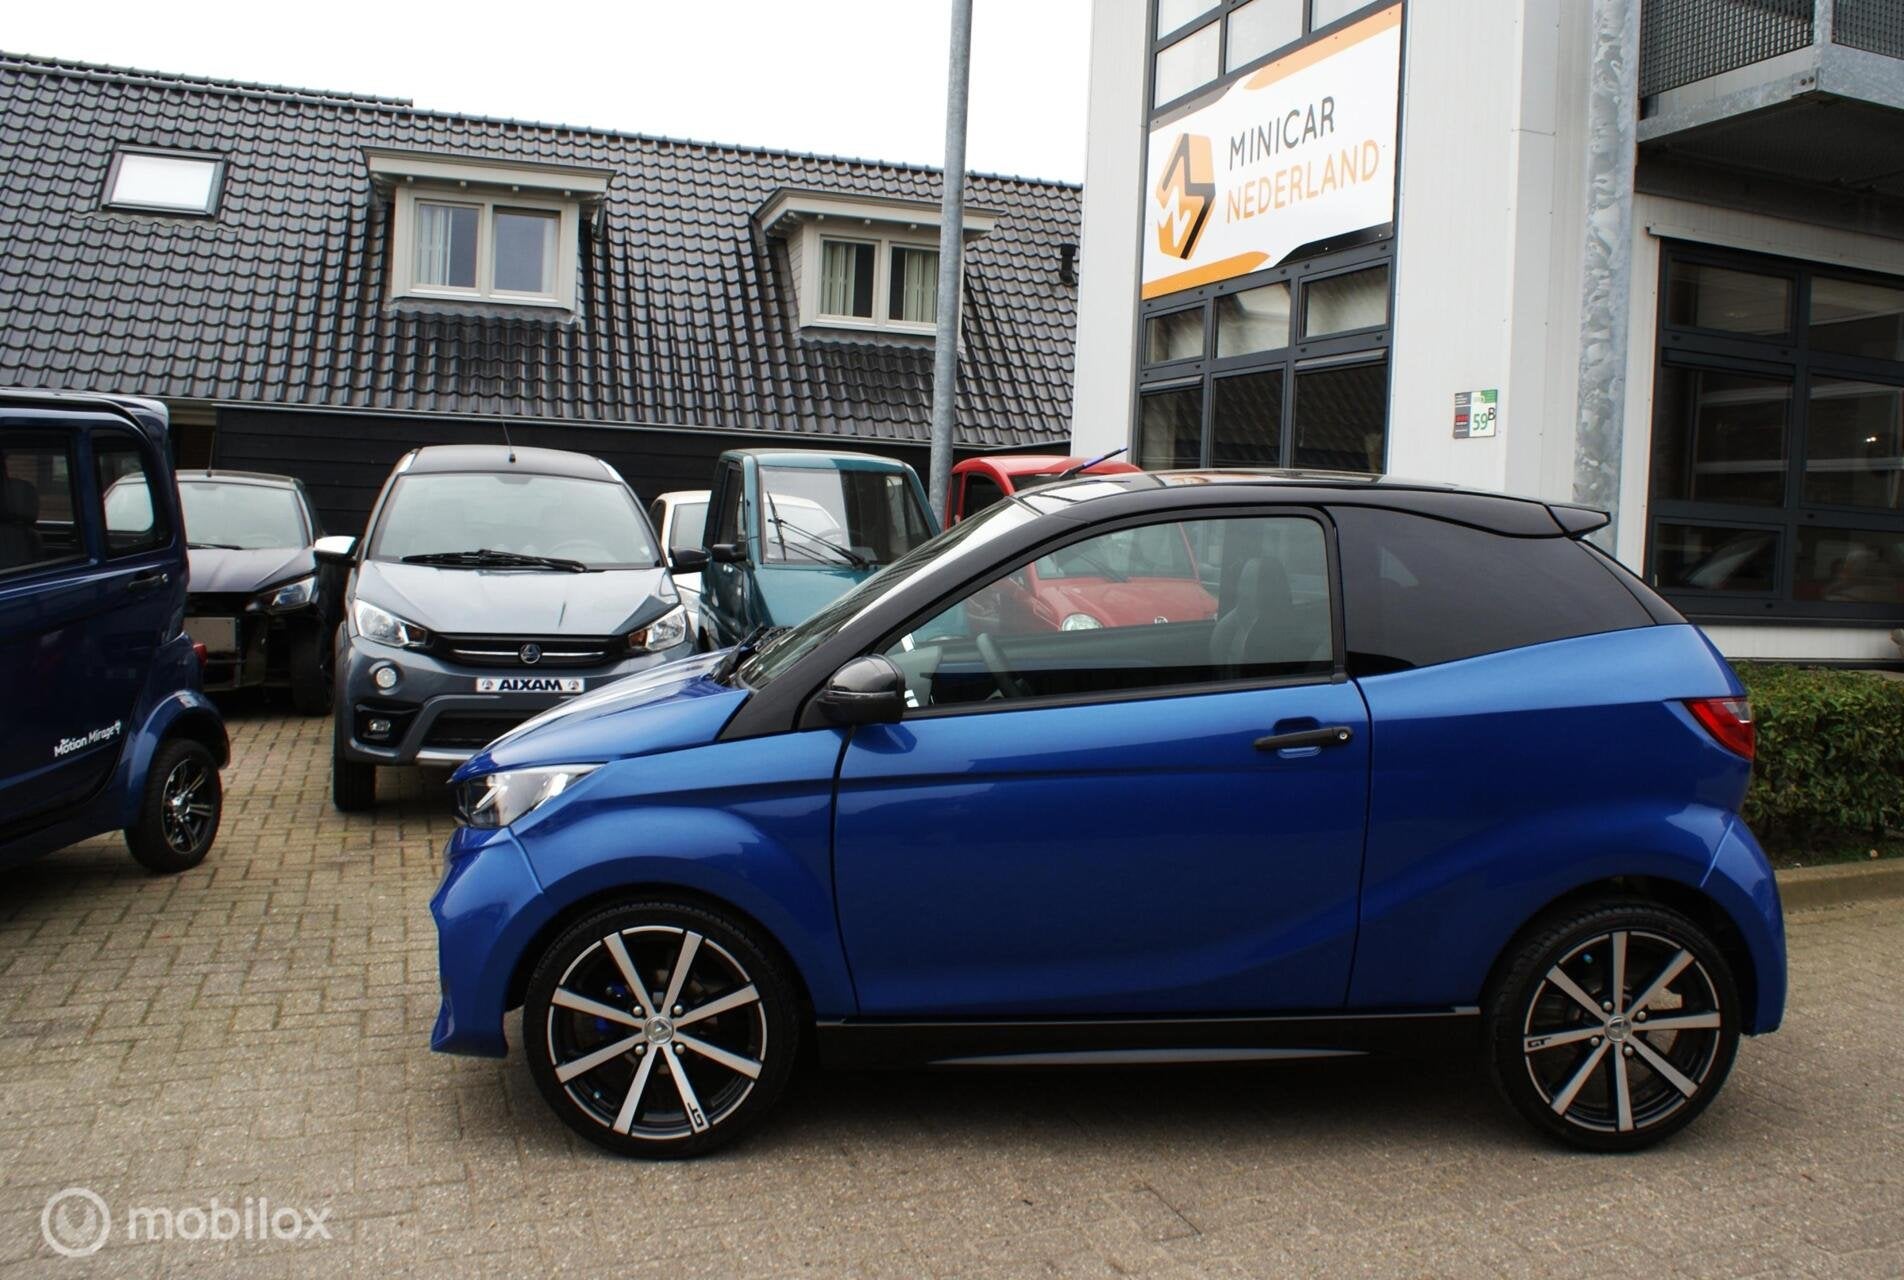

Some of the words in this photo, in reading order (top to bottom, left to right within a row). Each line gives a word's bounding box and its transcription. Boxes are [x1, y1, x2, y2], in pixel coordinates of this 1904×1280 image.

[1229, 96, 1335, 172] MINICAR
[1226, 139, 1380, 224] NEDERLAND
[498, 679, 563, 691] AIXAM
